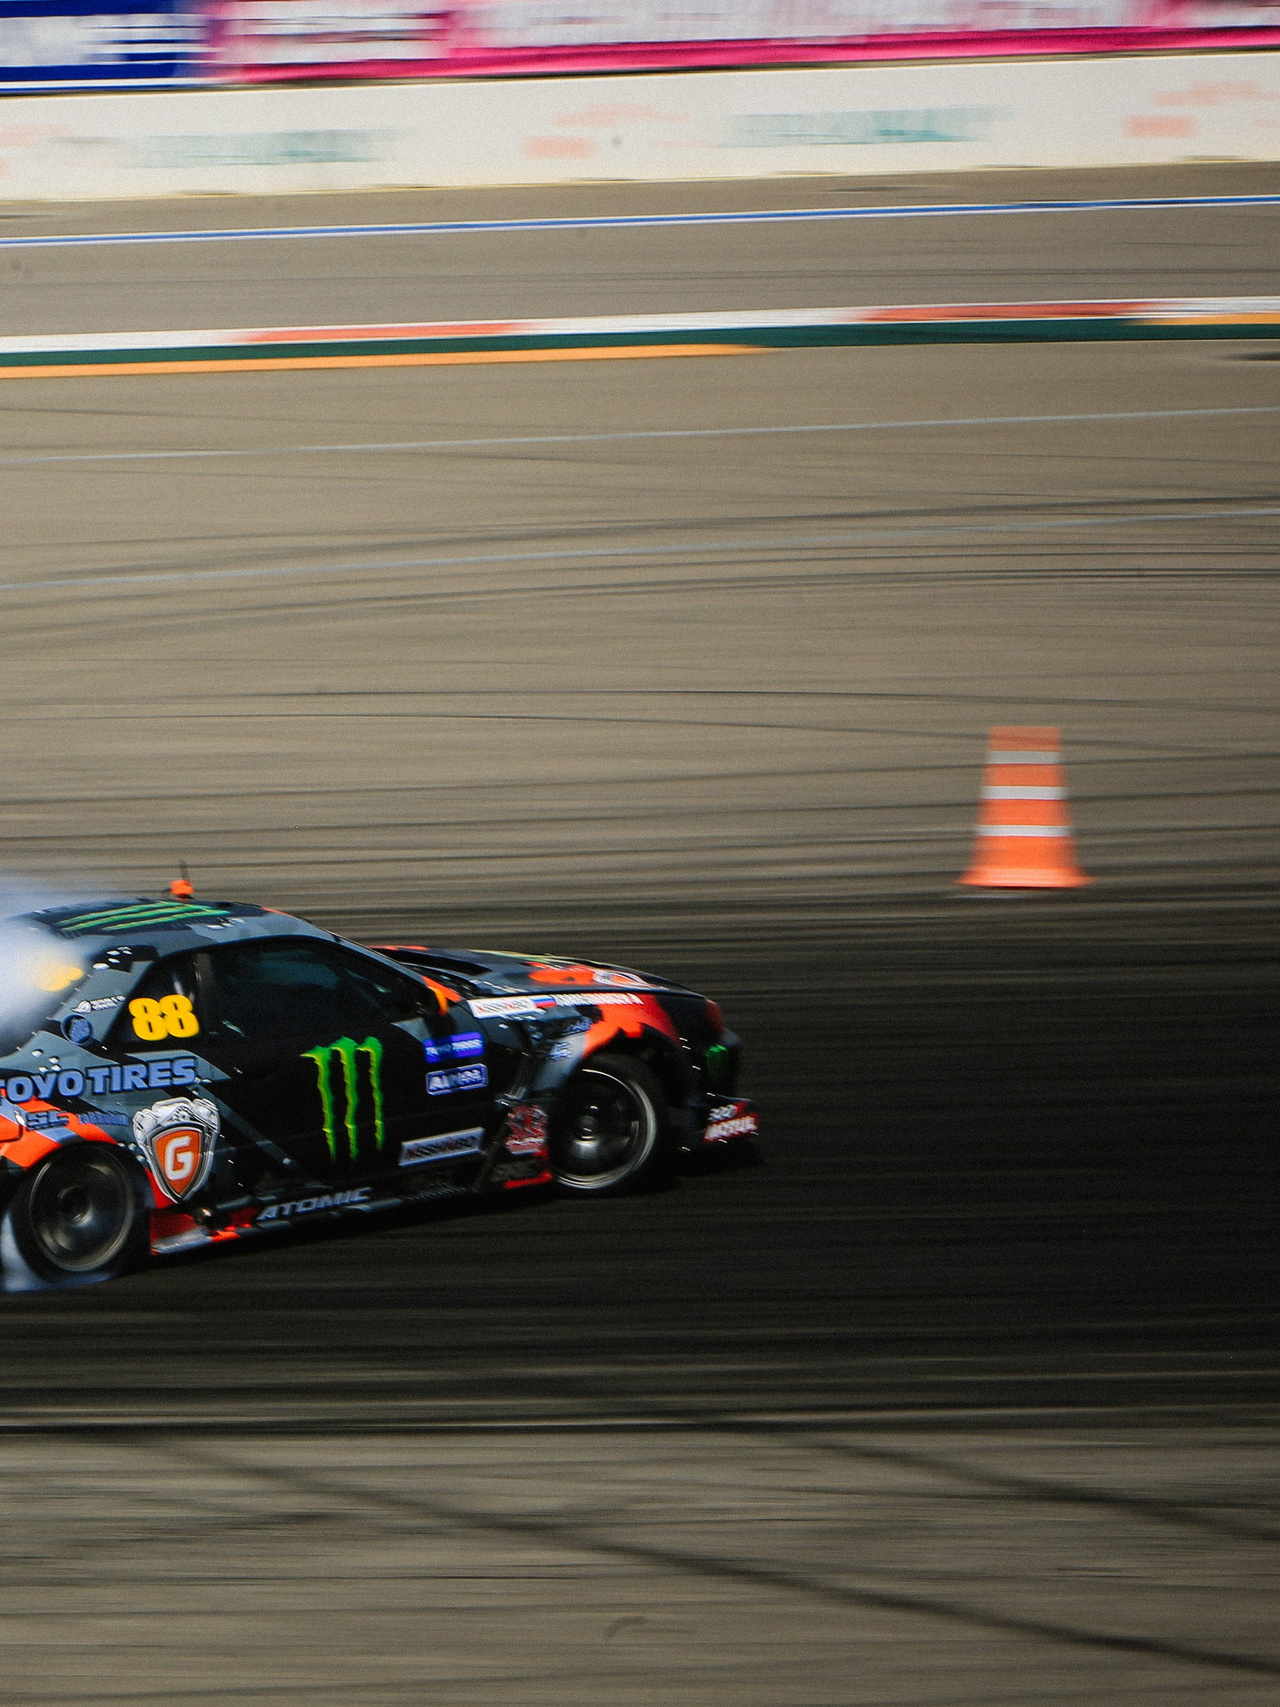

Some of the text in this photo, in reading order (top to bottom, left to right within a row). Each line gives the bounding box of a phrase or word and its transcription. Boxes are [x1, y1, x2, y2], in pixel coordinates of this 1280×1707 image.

[128, 994, 200, 1041] 88
[87, 1057, 197, 1094] TIRES
[164, 1136, 194, 1181] G
[256, 1187, 373, 1221] ATOMIC
